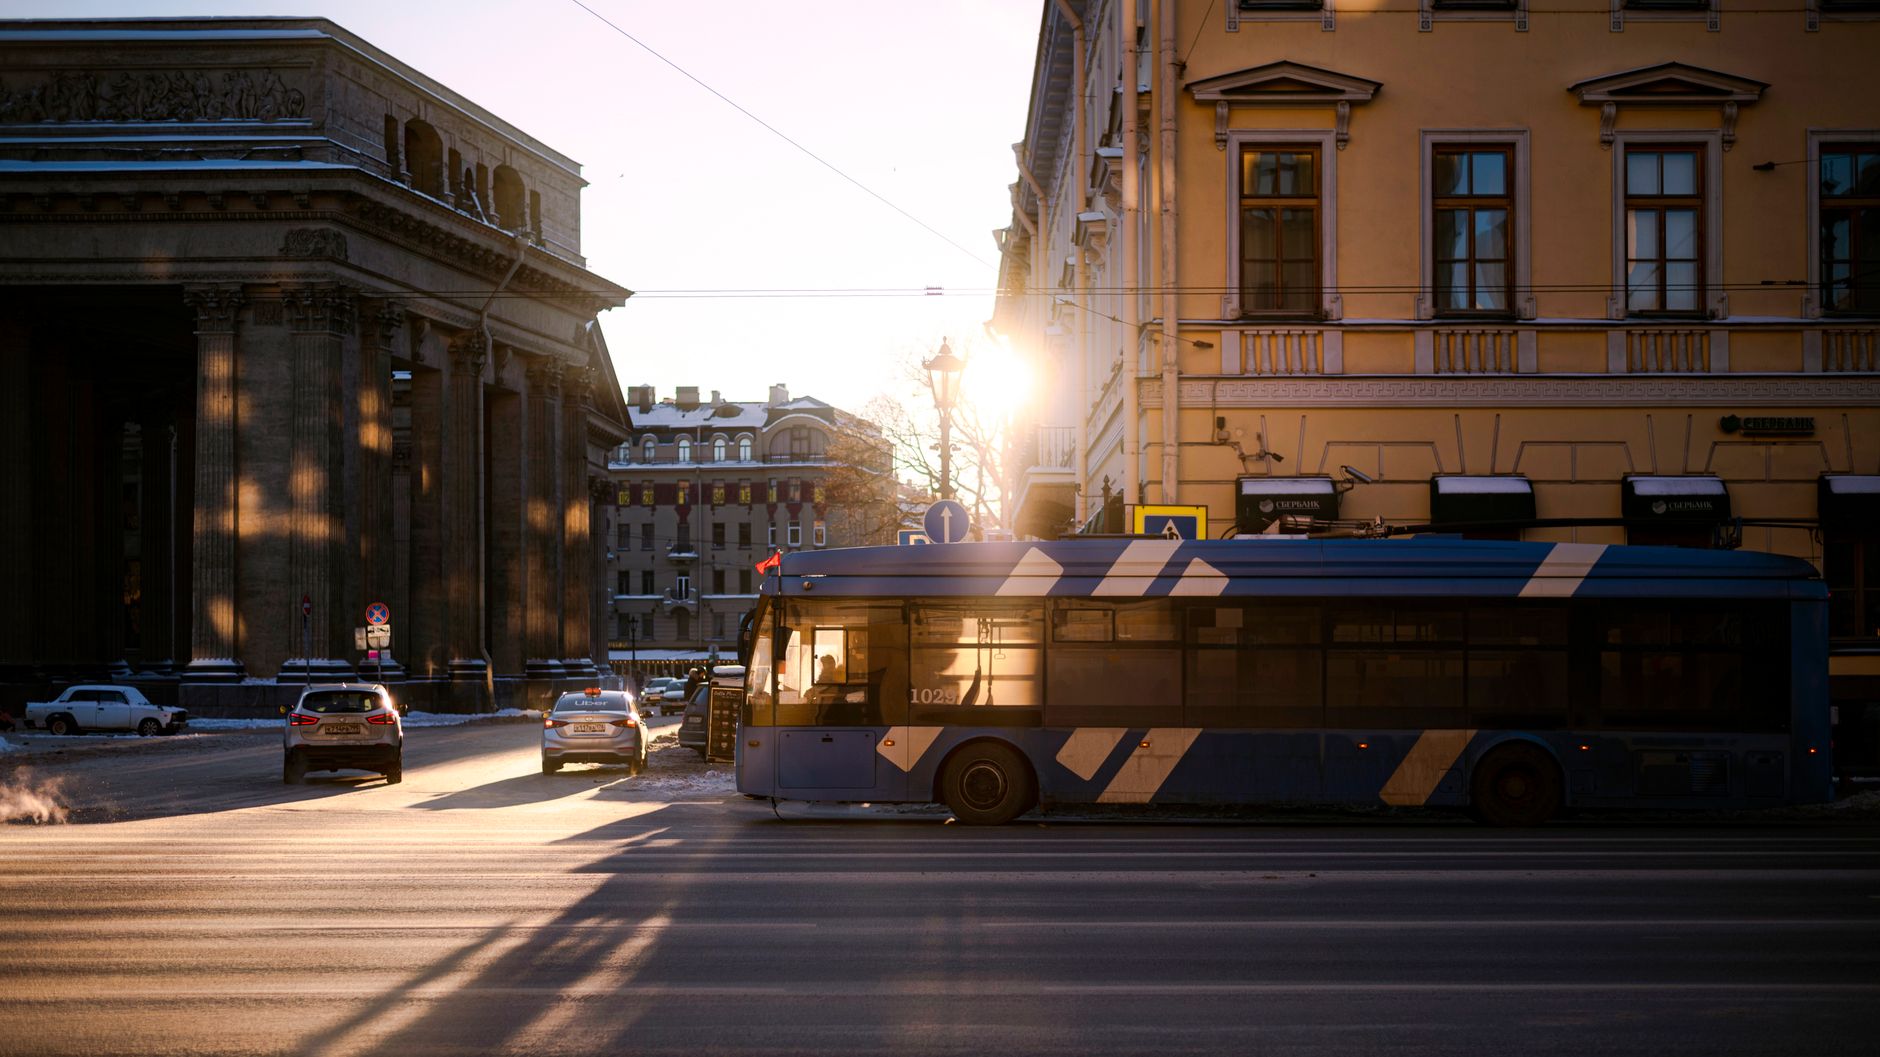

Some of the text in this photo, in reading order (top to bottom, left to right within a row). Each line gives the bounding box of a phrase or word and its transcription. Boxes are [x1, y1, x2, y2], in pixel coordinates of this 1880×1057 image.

[1275, 500, 1321, 509] СБЕРБАНК
[1668, 501, 1714, 510] СБЕРБАНК
[910, 688, 957, 705] 1029
